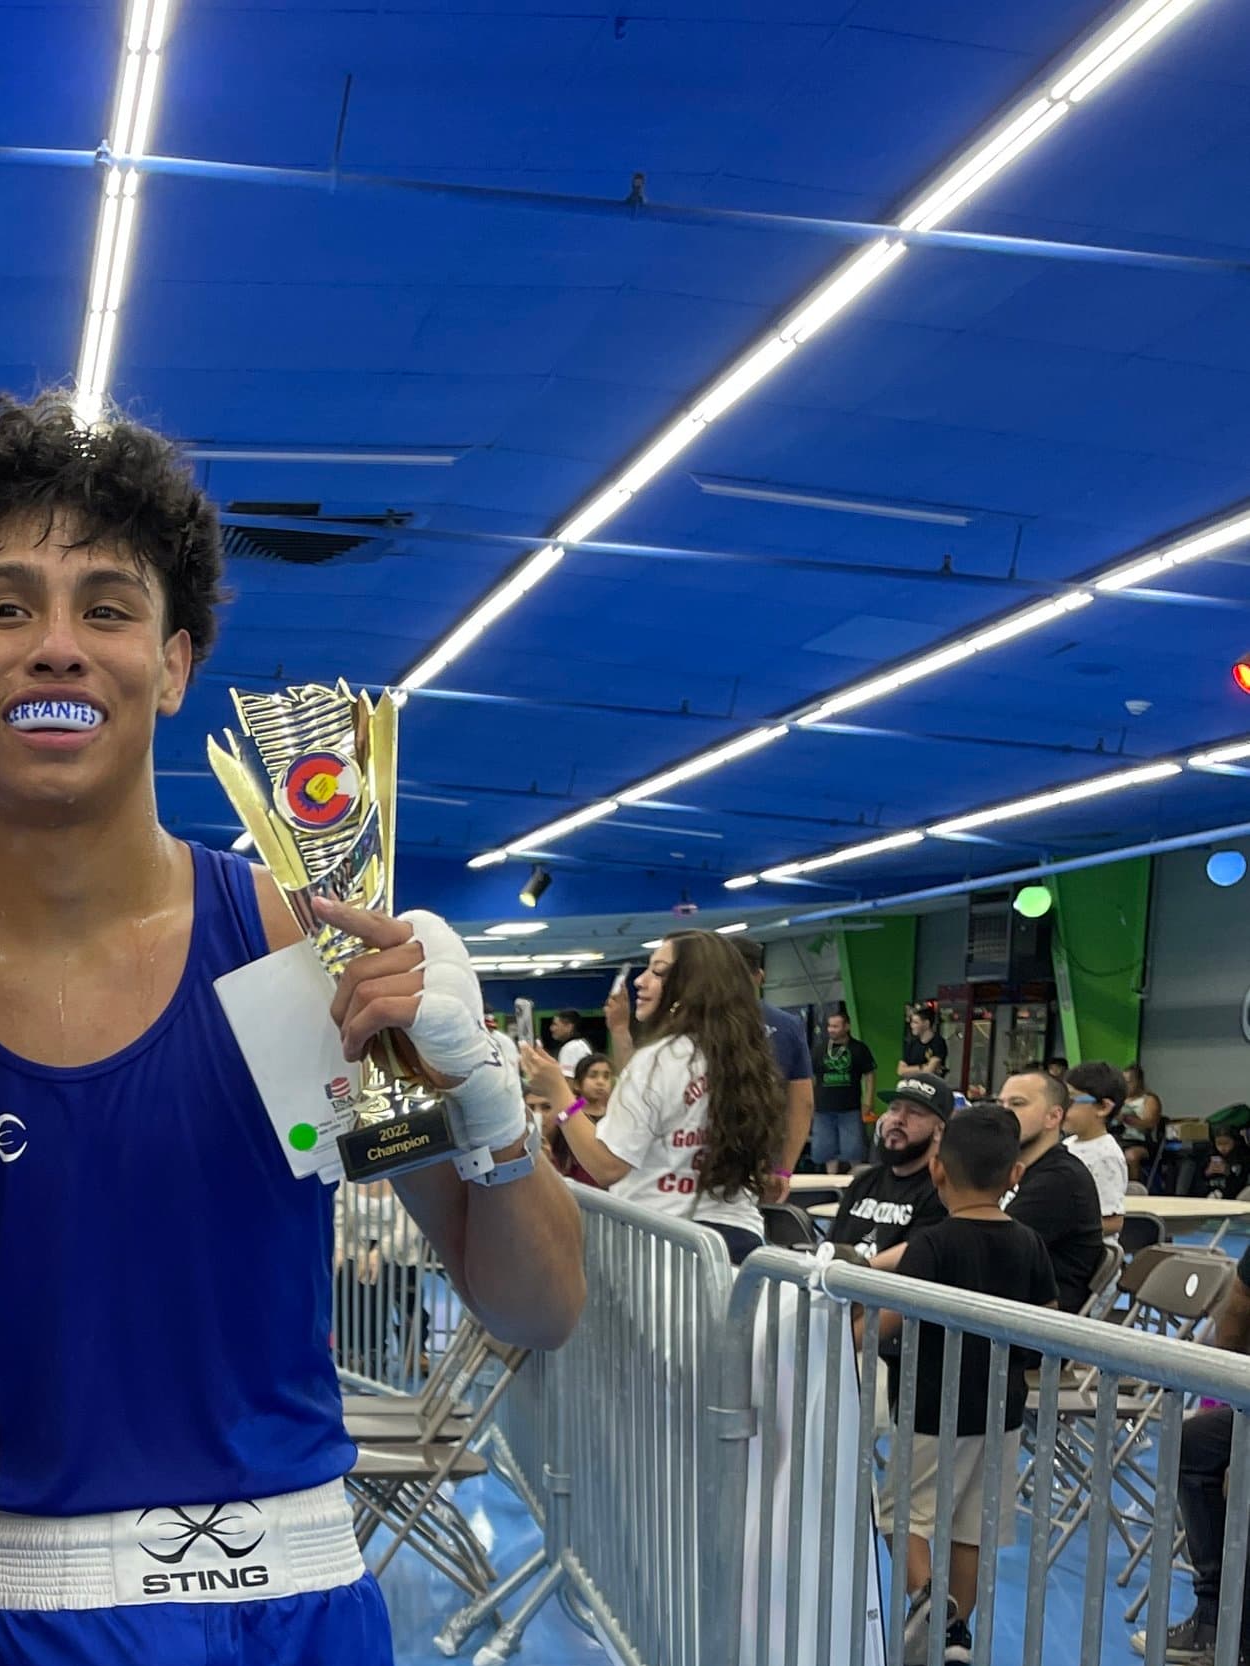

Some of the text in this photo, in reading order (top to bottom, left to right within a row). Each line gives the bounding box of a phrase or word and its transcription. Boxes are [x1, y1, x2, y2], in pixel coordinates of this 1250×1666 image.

[378, 1122, 411, 1143] 2022
[366, 1133, 431, 1162] Champion
[142, 1565, 270, 1596] STING
